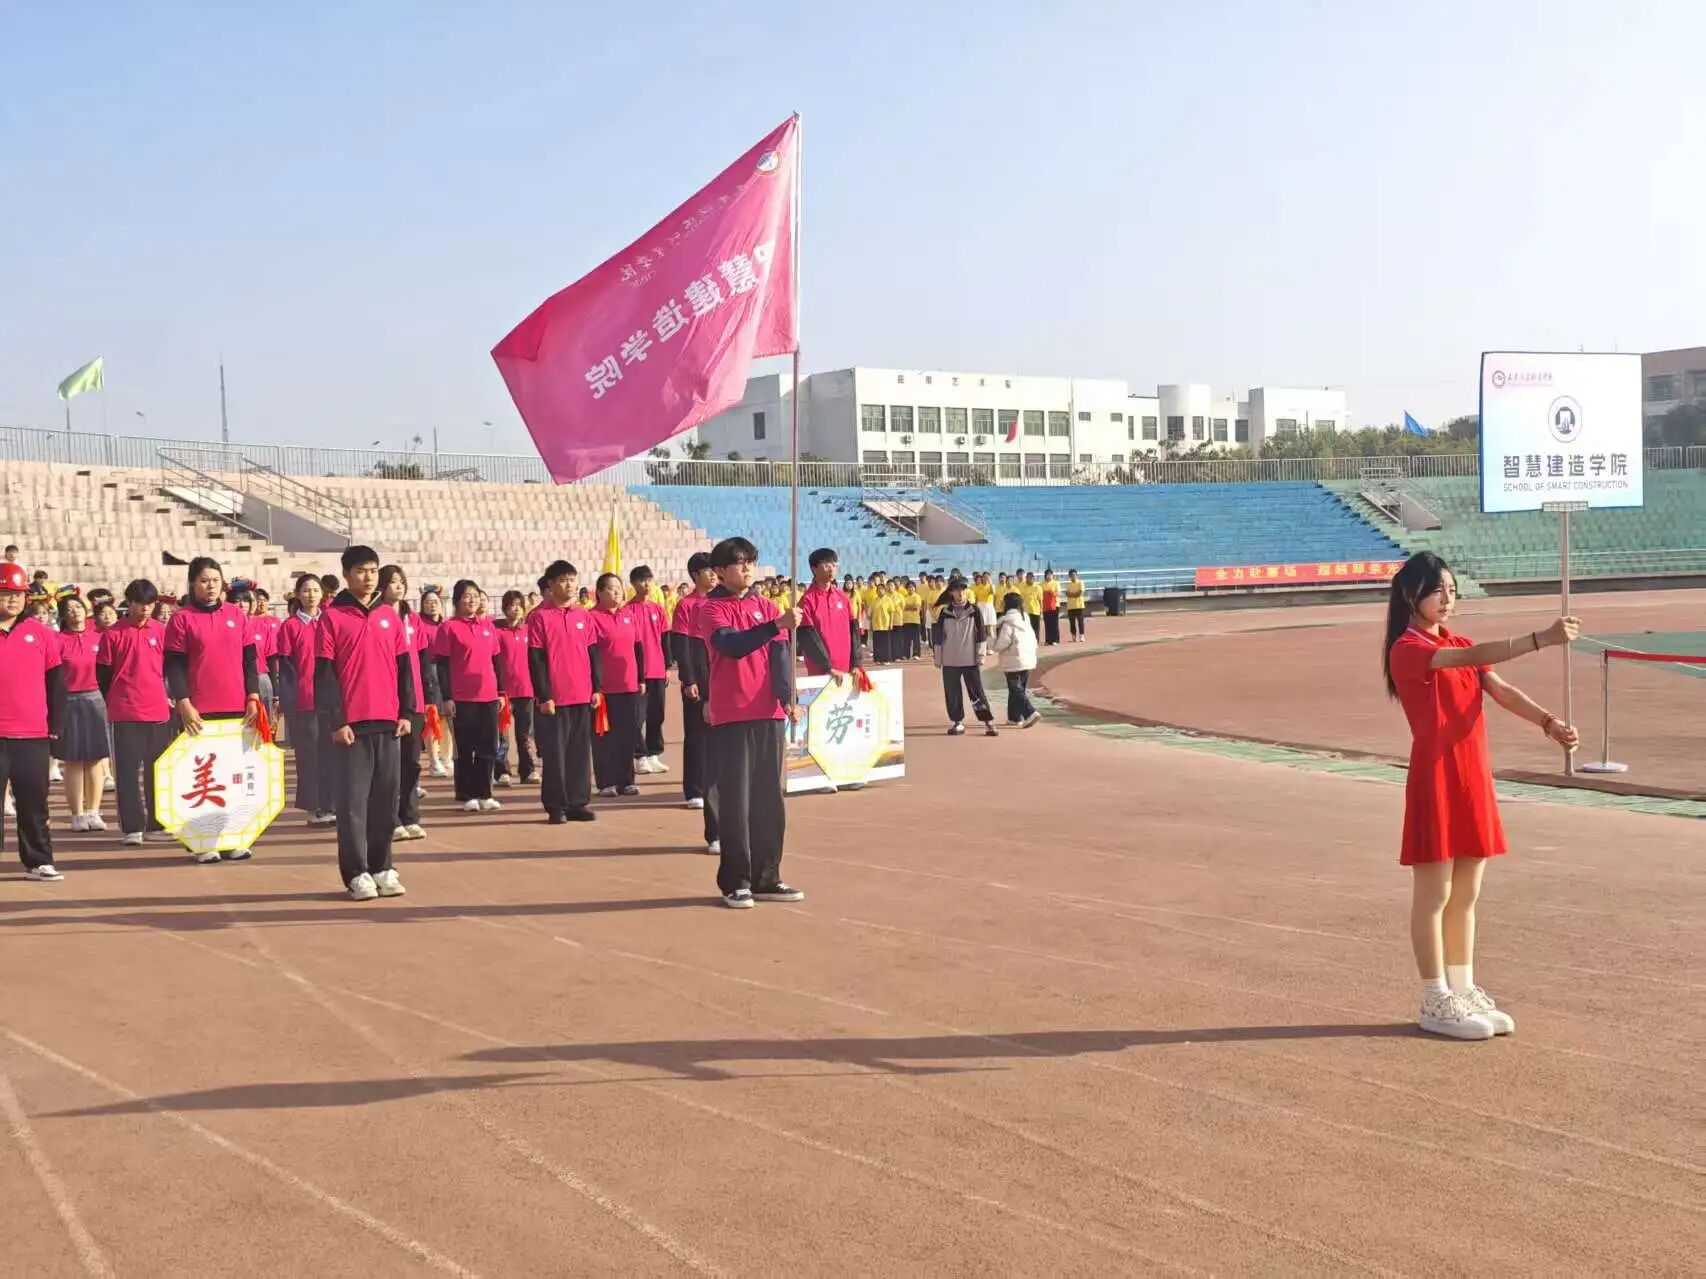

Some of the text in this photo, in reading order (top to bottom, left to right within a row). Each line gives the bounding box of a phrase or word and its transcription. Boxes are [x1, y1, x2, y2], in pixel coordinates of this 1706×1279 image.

[1503, 453, 1628, 478] 智慧建造学院
[1503, 480, 1629, 492] SCHOOL OF SMART CONSTRUCTION
[825, 702, 855, 745] 劳
[181, 752, 226, 809] 美
